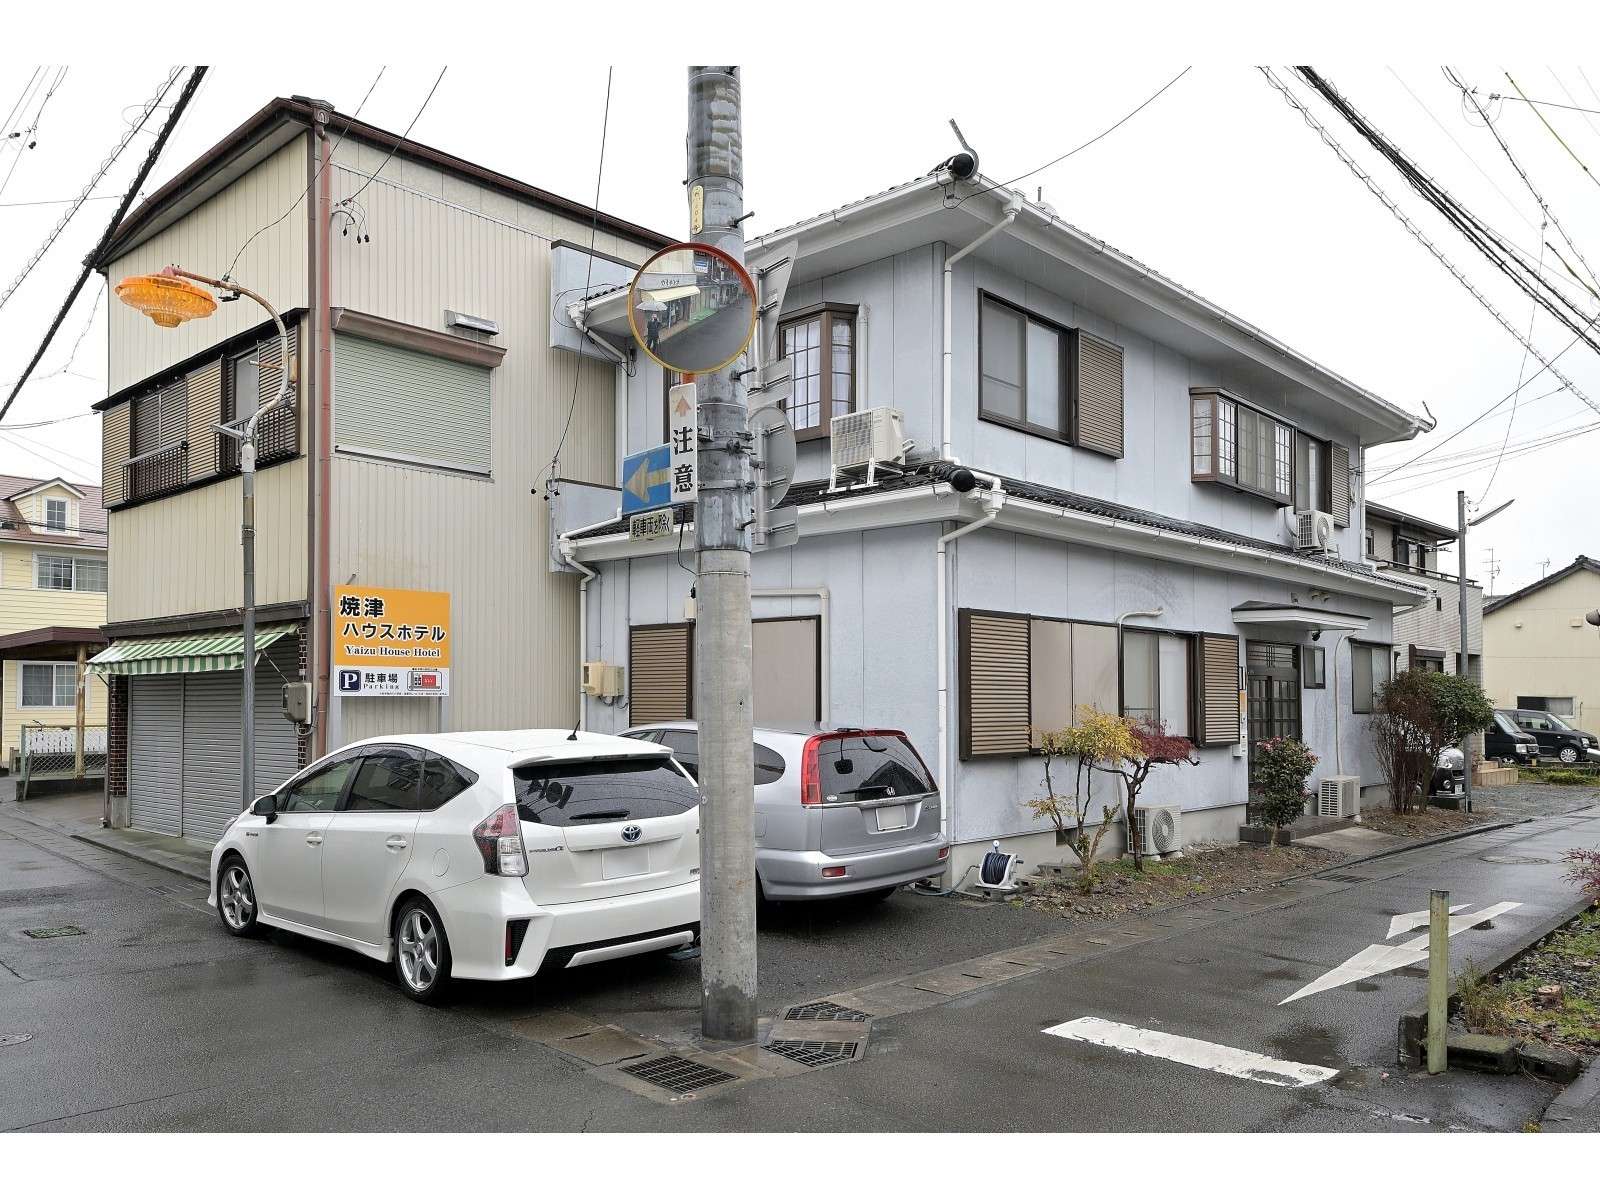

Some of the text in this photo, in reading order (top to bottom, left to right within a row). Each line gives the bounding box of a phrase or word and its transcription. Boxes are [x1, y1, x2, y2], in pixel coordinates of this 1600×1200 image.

[673, 426, 694, 493] 注意
[340, 596, 384, 617] 焼津
[343, 622, 446, 641] ハウスホテル
[346, 645, 441, 658] Yaizu House Hotel
[342, 672, 358, 689] P
[364, 672, 398, 684] 駐車場
